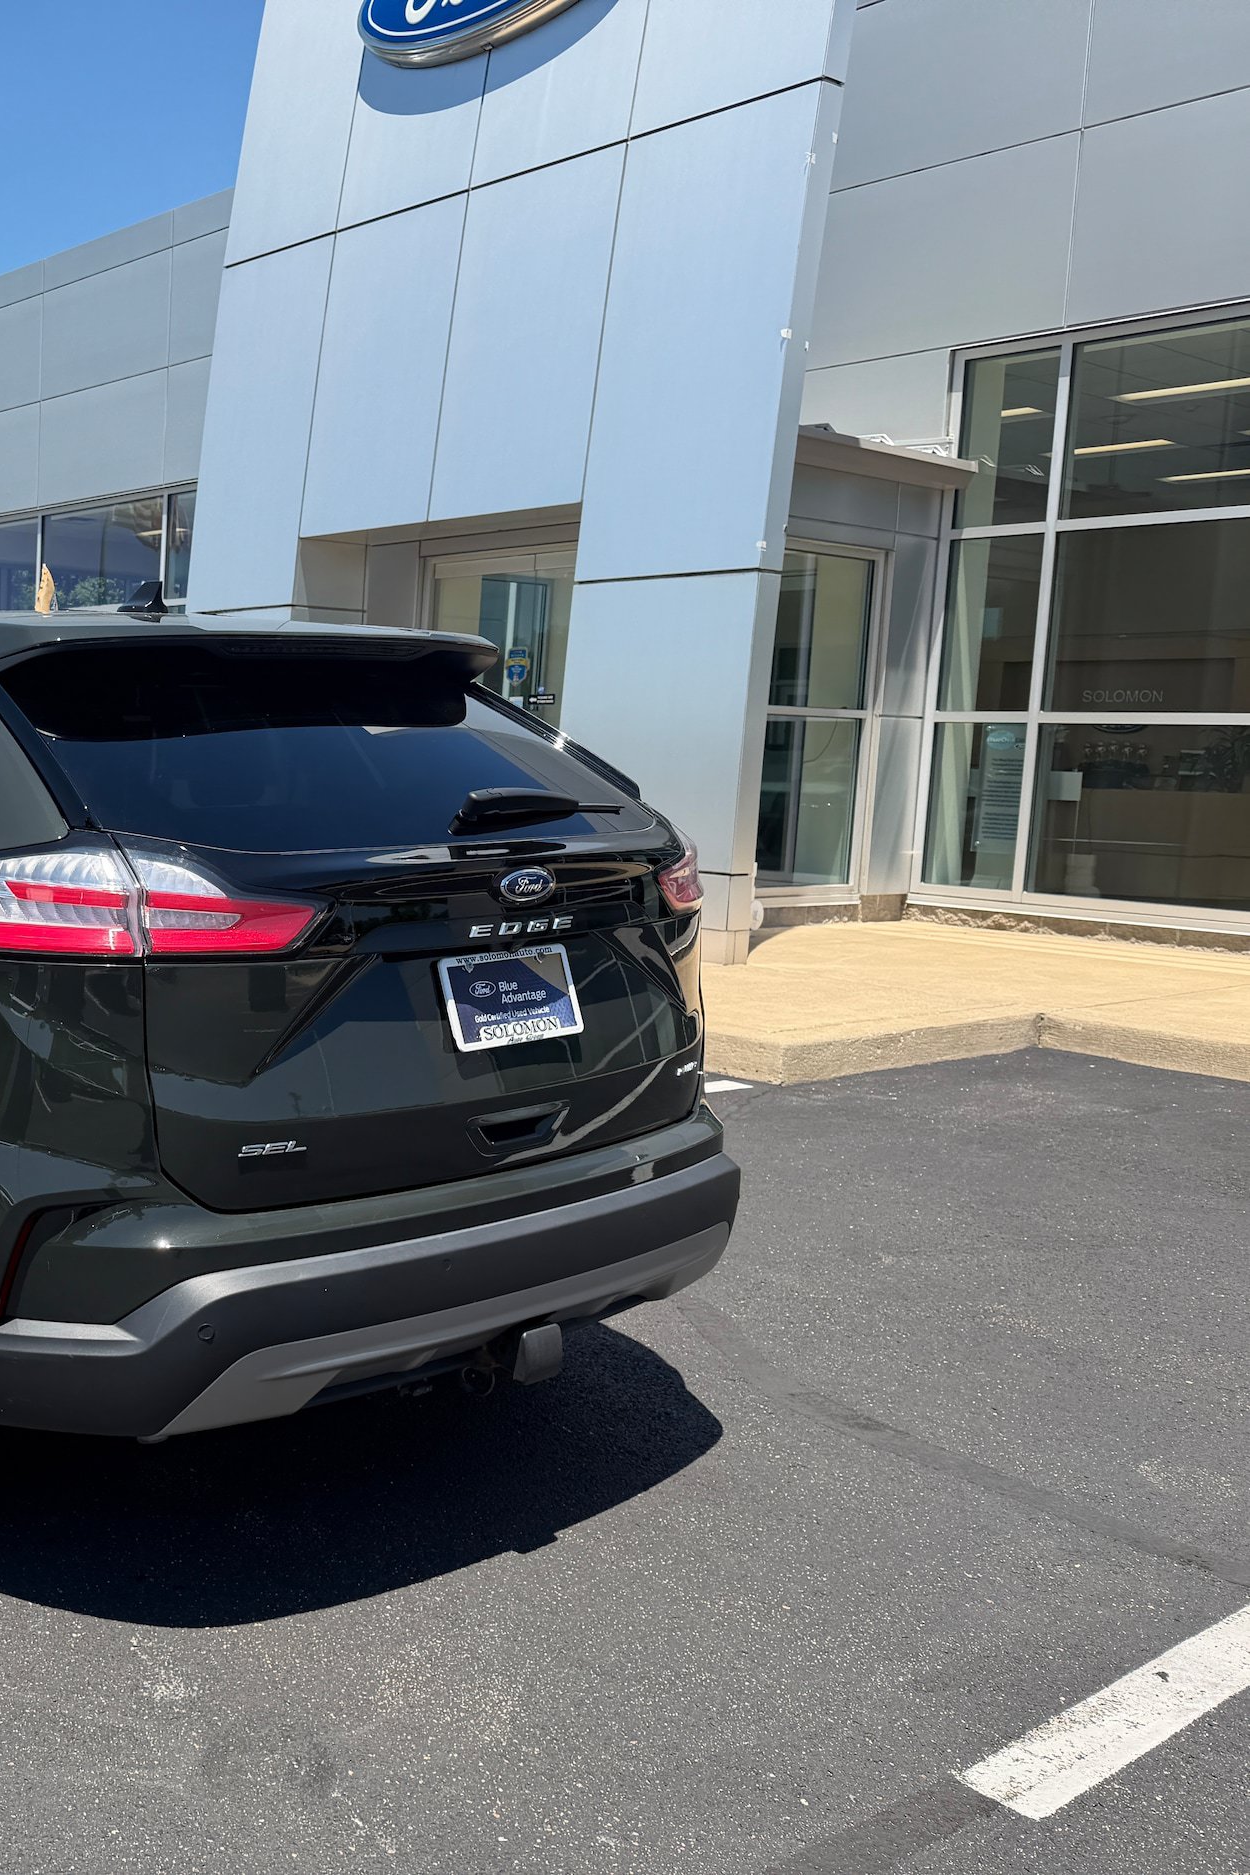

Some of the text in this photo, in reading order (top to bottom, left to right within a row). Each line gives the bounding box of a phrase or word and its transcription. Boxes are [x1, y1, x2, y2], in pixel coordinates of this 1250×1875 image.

[1081, 689, 1164, 703] SOLOMON
[515, 875, 544, 895] Ford
[469, 915, 574, 938] EDGE
[498, 980, 519, 993] Blue
[501, 990, 547, 1005] Advantage
[475, 1013, 487, 1023] Gold
[511, 1008, 527, 1018] Used
[483, 1017, 559, 1041] SOLOMON
[237, 1140, 307, 1157] SEL
